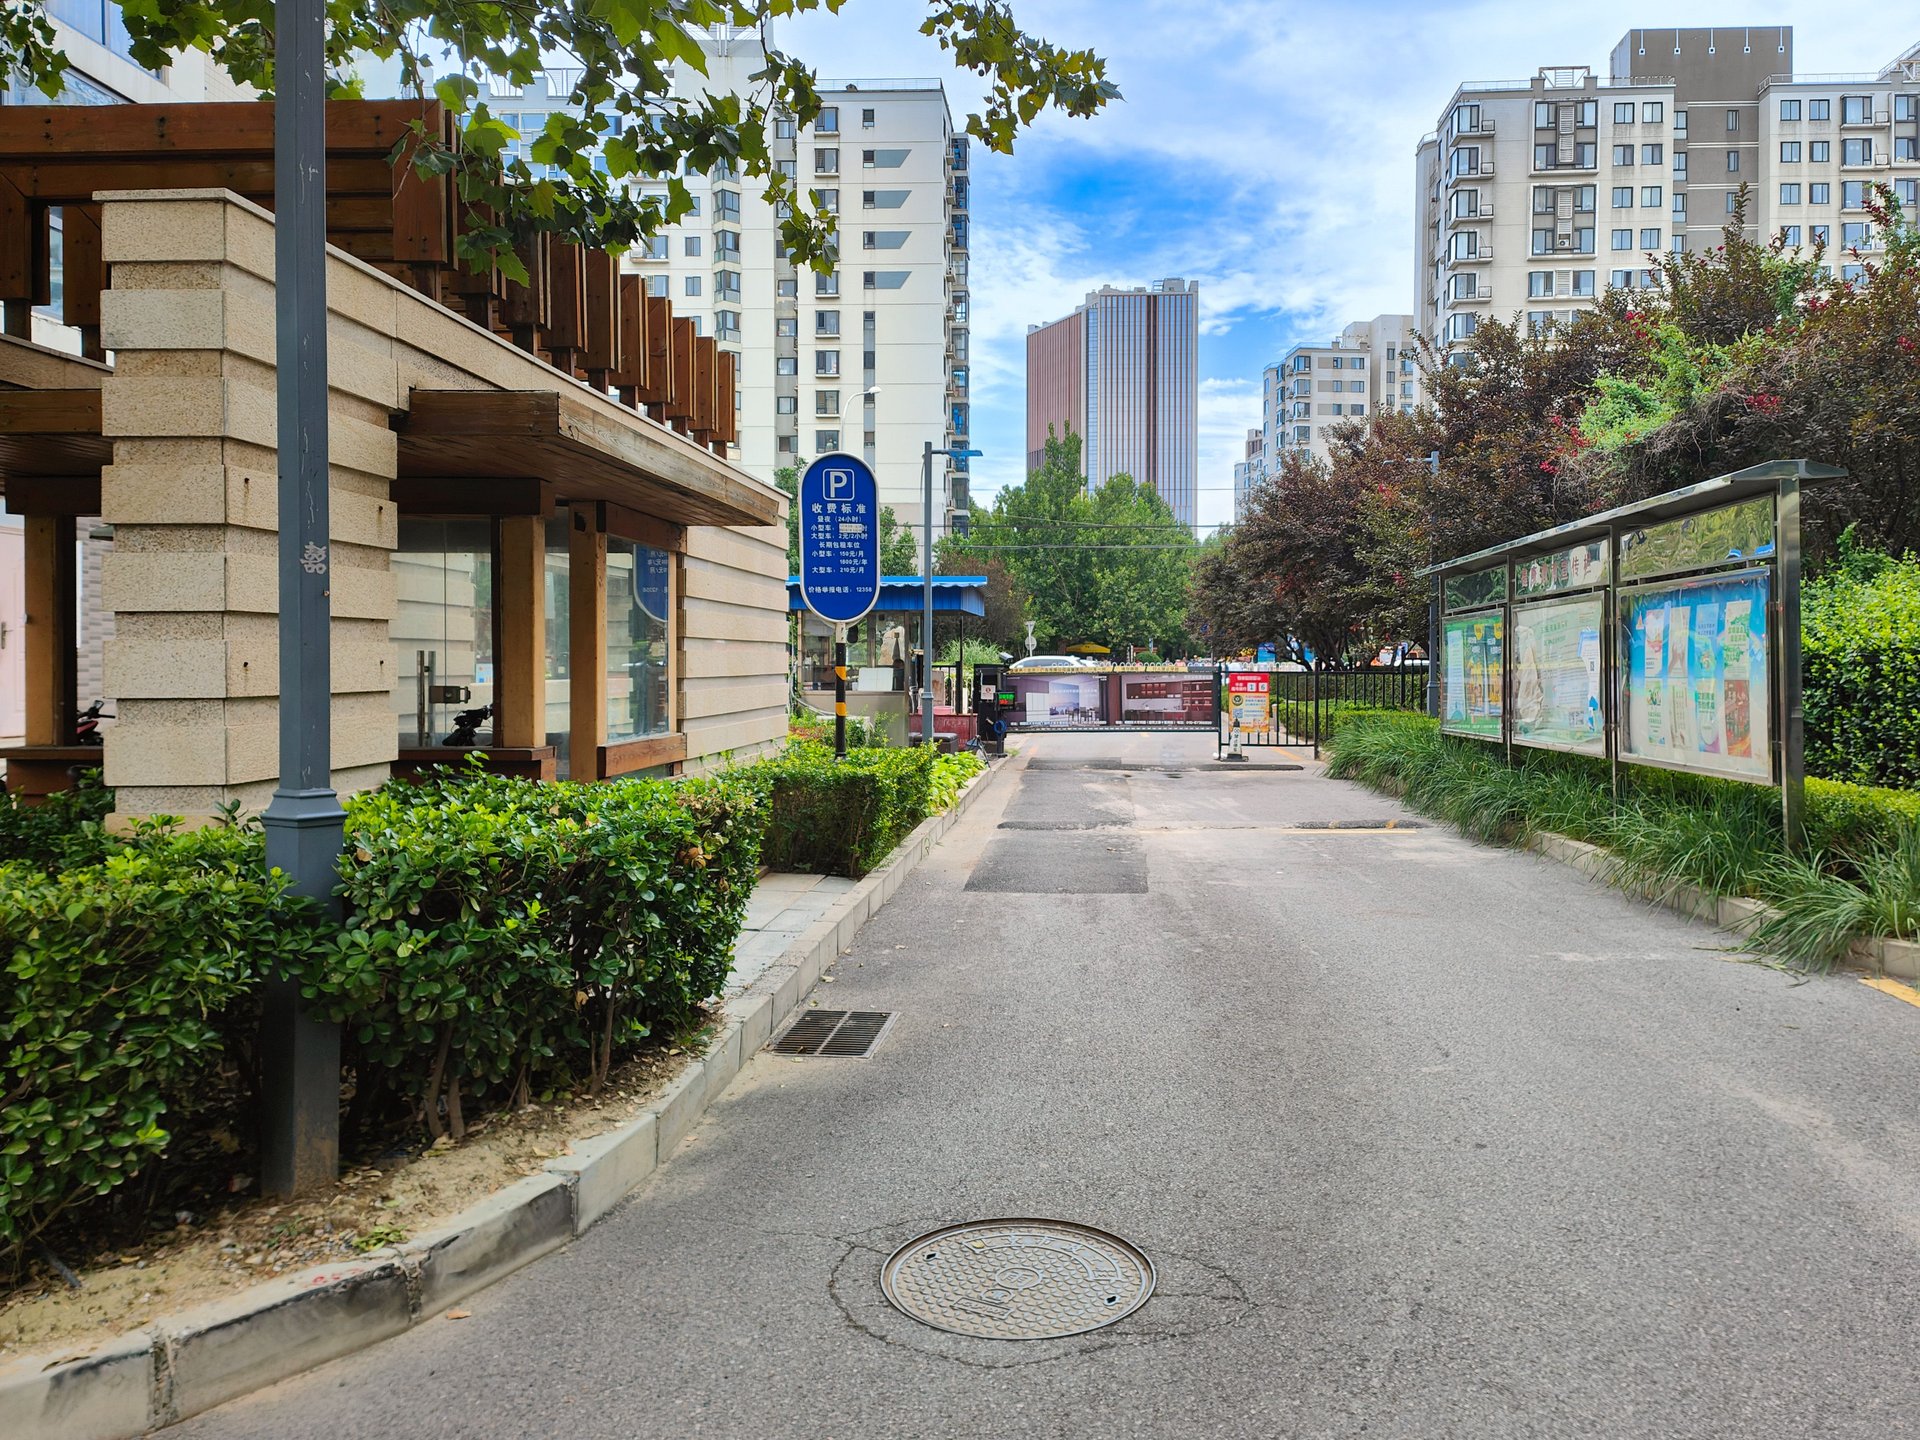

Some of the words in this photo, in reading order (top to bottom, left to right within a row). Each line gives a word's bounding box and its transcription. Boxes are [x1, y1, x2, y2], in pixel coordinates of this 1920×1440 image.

[830, 471, 848, 498] P
[811, 503, 867, 514] 收费标准
[819, 541, 861, 549] 长期包租车位
